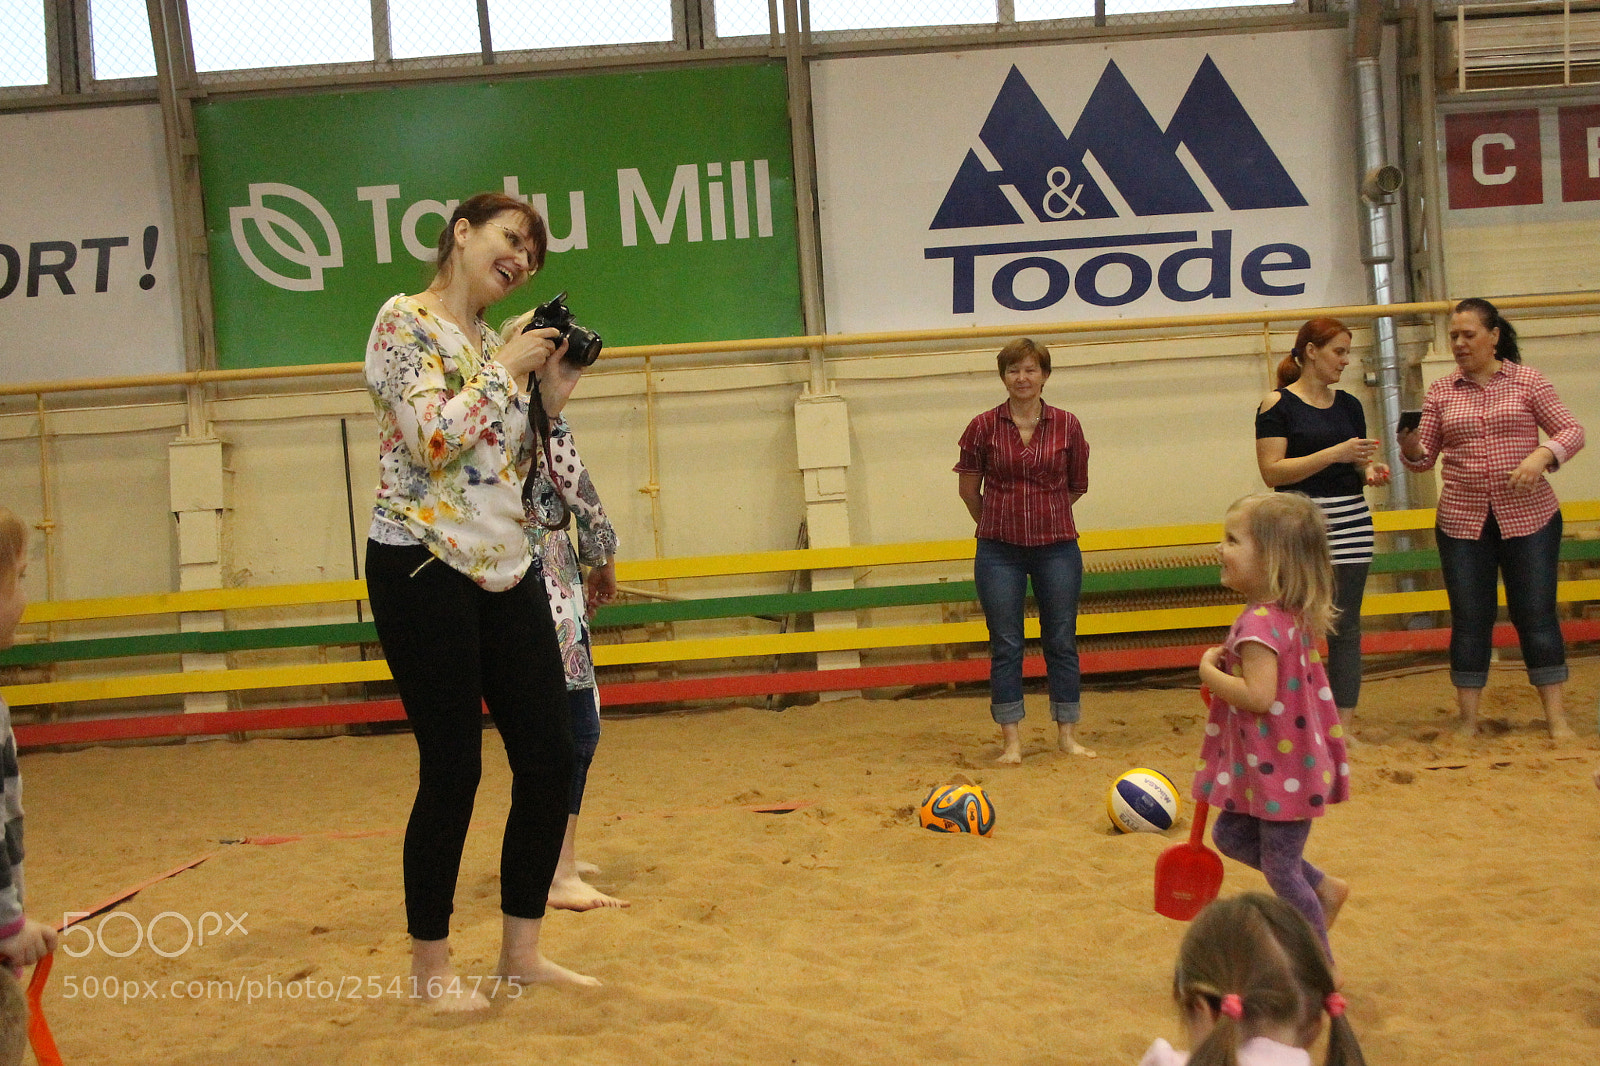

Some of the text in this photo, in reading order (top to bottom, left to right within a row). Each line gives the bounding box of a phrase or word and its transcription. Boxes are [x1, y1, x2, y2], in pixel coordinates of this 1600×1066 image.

[356, 159, 774, 265] Tau Mill
[1042, 166, 1087, 219] &
[924, 229, 1312, 315] Toode
